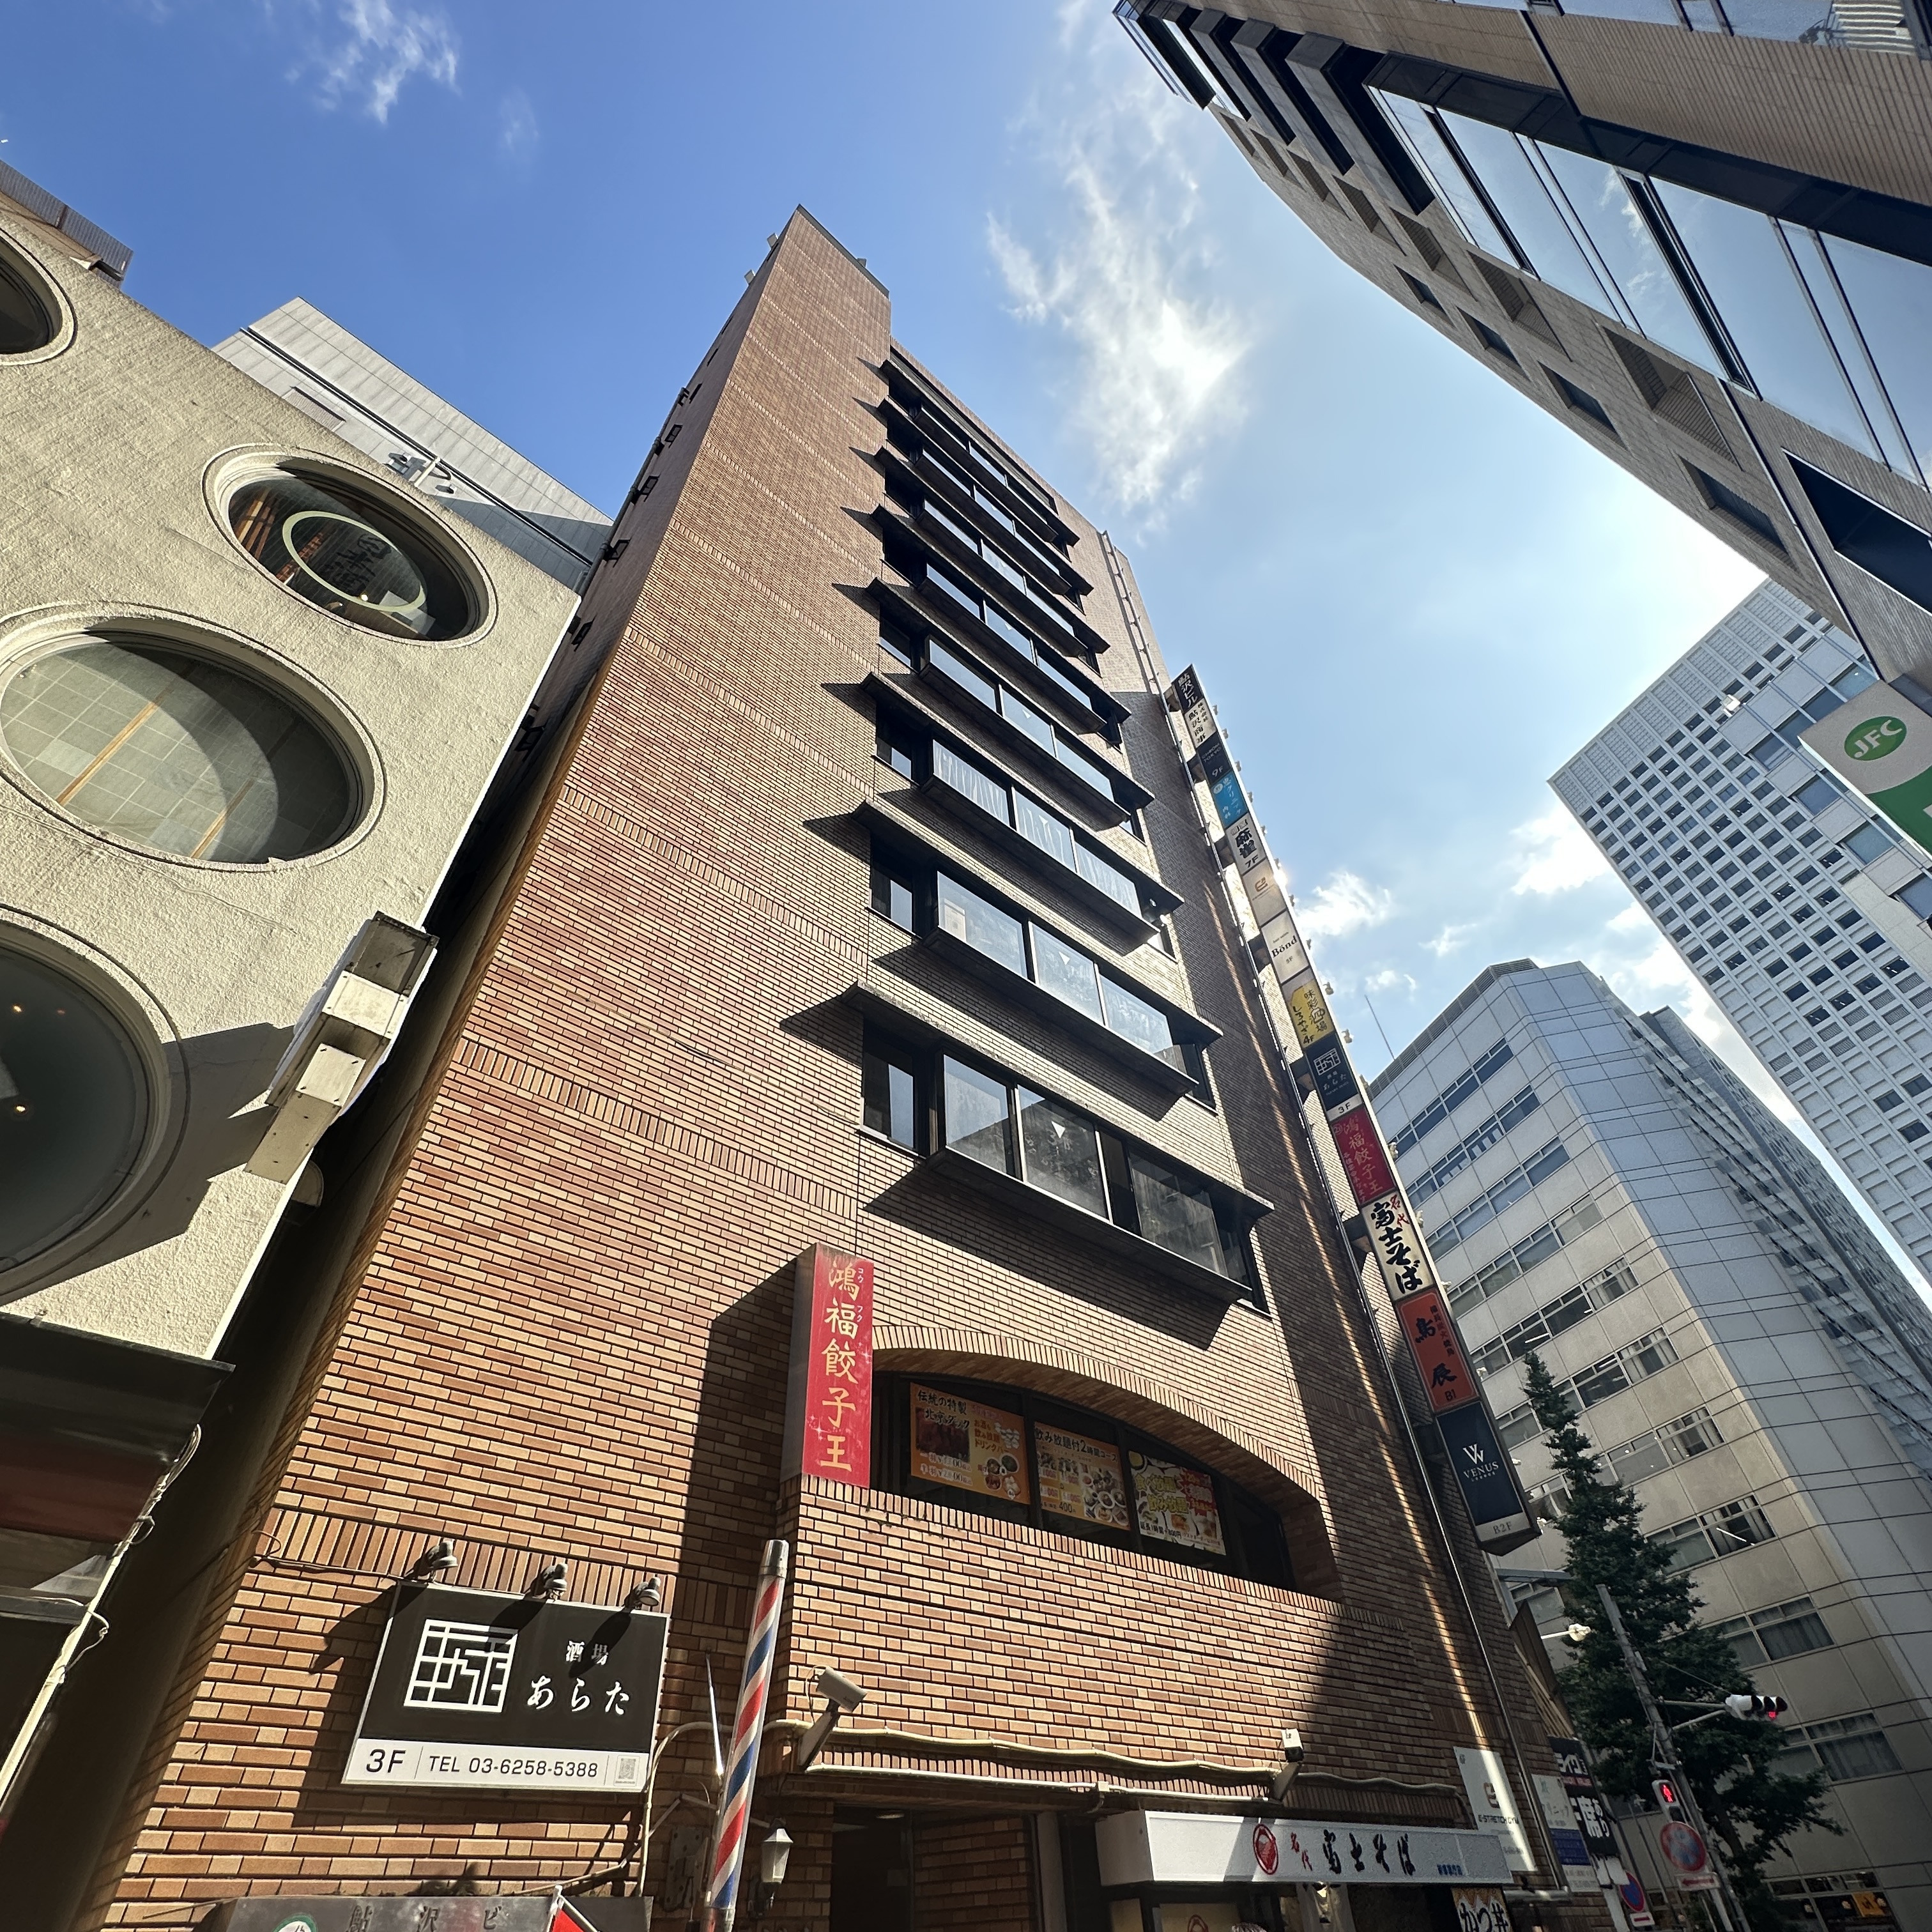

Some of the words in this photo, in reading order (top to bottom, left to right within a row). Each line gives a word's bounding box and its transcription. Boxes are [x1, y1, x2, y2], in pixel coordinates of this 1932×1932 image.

[1854, 719, 1903, 758] JFC
[1212, 766, 1223, 778] 9F
[1245, 855, 1259, 868] 7F
[1271, 935, 1298, 958] Bönd
[1303, 1034, 1315, 1045] 4F
[1338, 1102, 1351, 1114] 3F
[1371, 1202, 1423, 1294] 富士そば
[820, 1261, 859, 1472] 鴻福餃子王
[917, 1390, 967, 1415] 伝統の特製
[1445, 1389, 1456, 1401] B1
[924, 1408, 970, 1430] 北京ダック
[1463, 1461, 1499, 1478] VENUS
[1492, 1521, 1512, 1534] B2F
[565, 1639, 609, 1665] 酒場
[527, 1675, 630, 1715] あらた
[365, 1748, 406, 1774] 3F
[429, 1755, 461, 1773] TEL
[469, 1757, 598, 1777] 03-6258-5388
[1322, 1829, 1416, 1876] 富士そば
